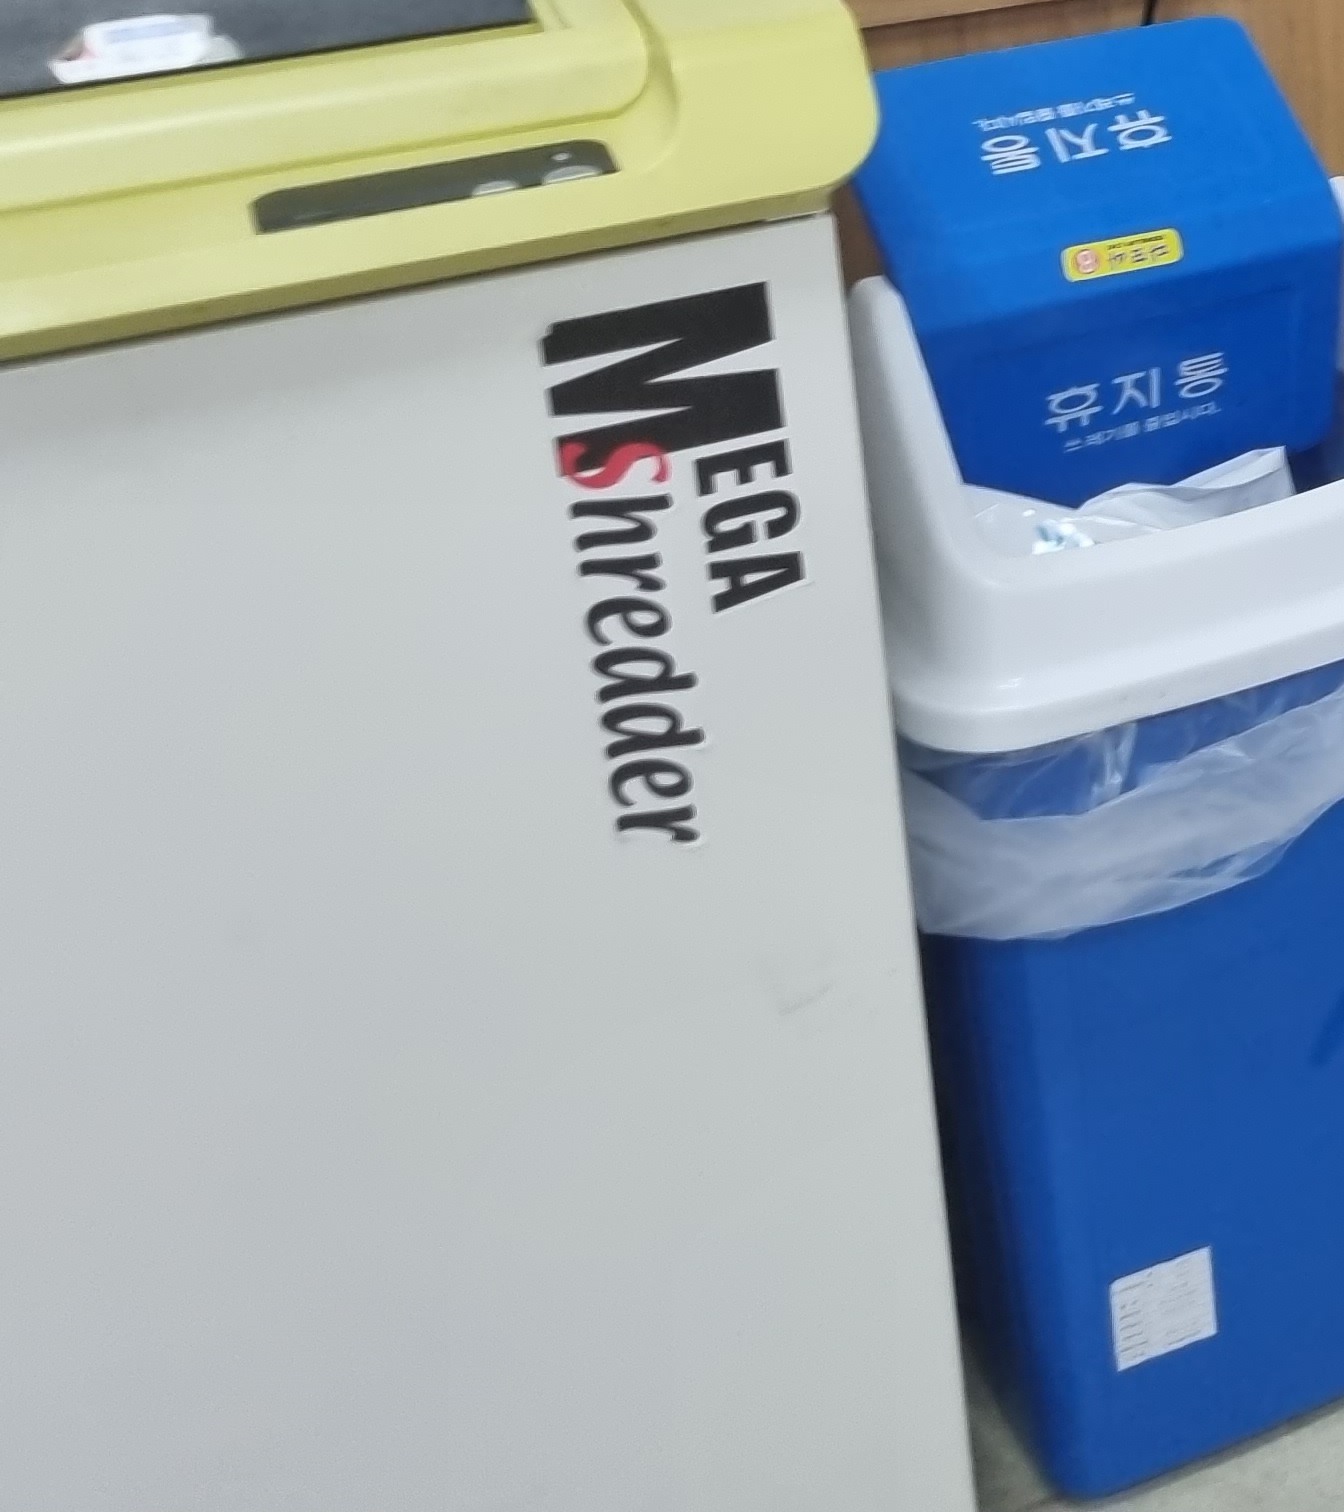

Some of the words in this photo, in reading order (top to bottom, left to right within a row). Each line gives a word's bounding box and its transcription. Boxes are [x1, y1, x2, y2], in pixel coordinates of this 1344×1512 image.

[981, 110, 1172, 175] 휴지통
[539, 281, 805, 614] MEGA
[1044, 352, 1229, 433] 휴지통
[555, 441, 705, 844] Shredder
